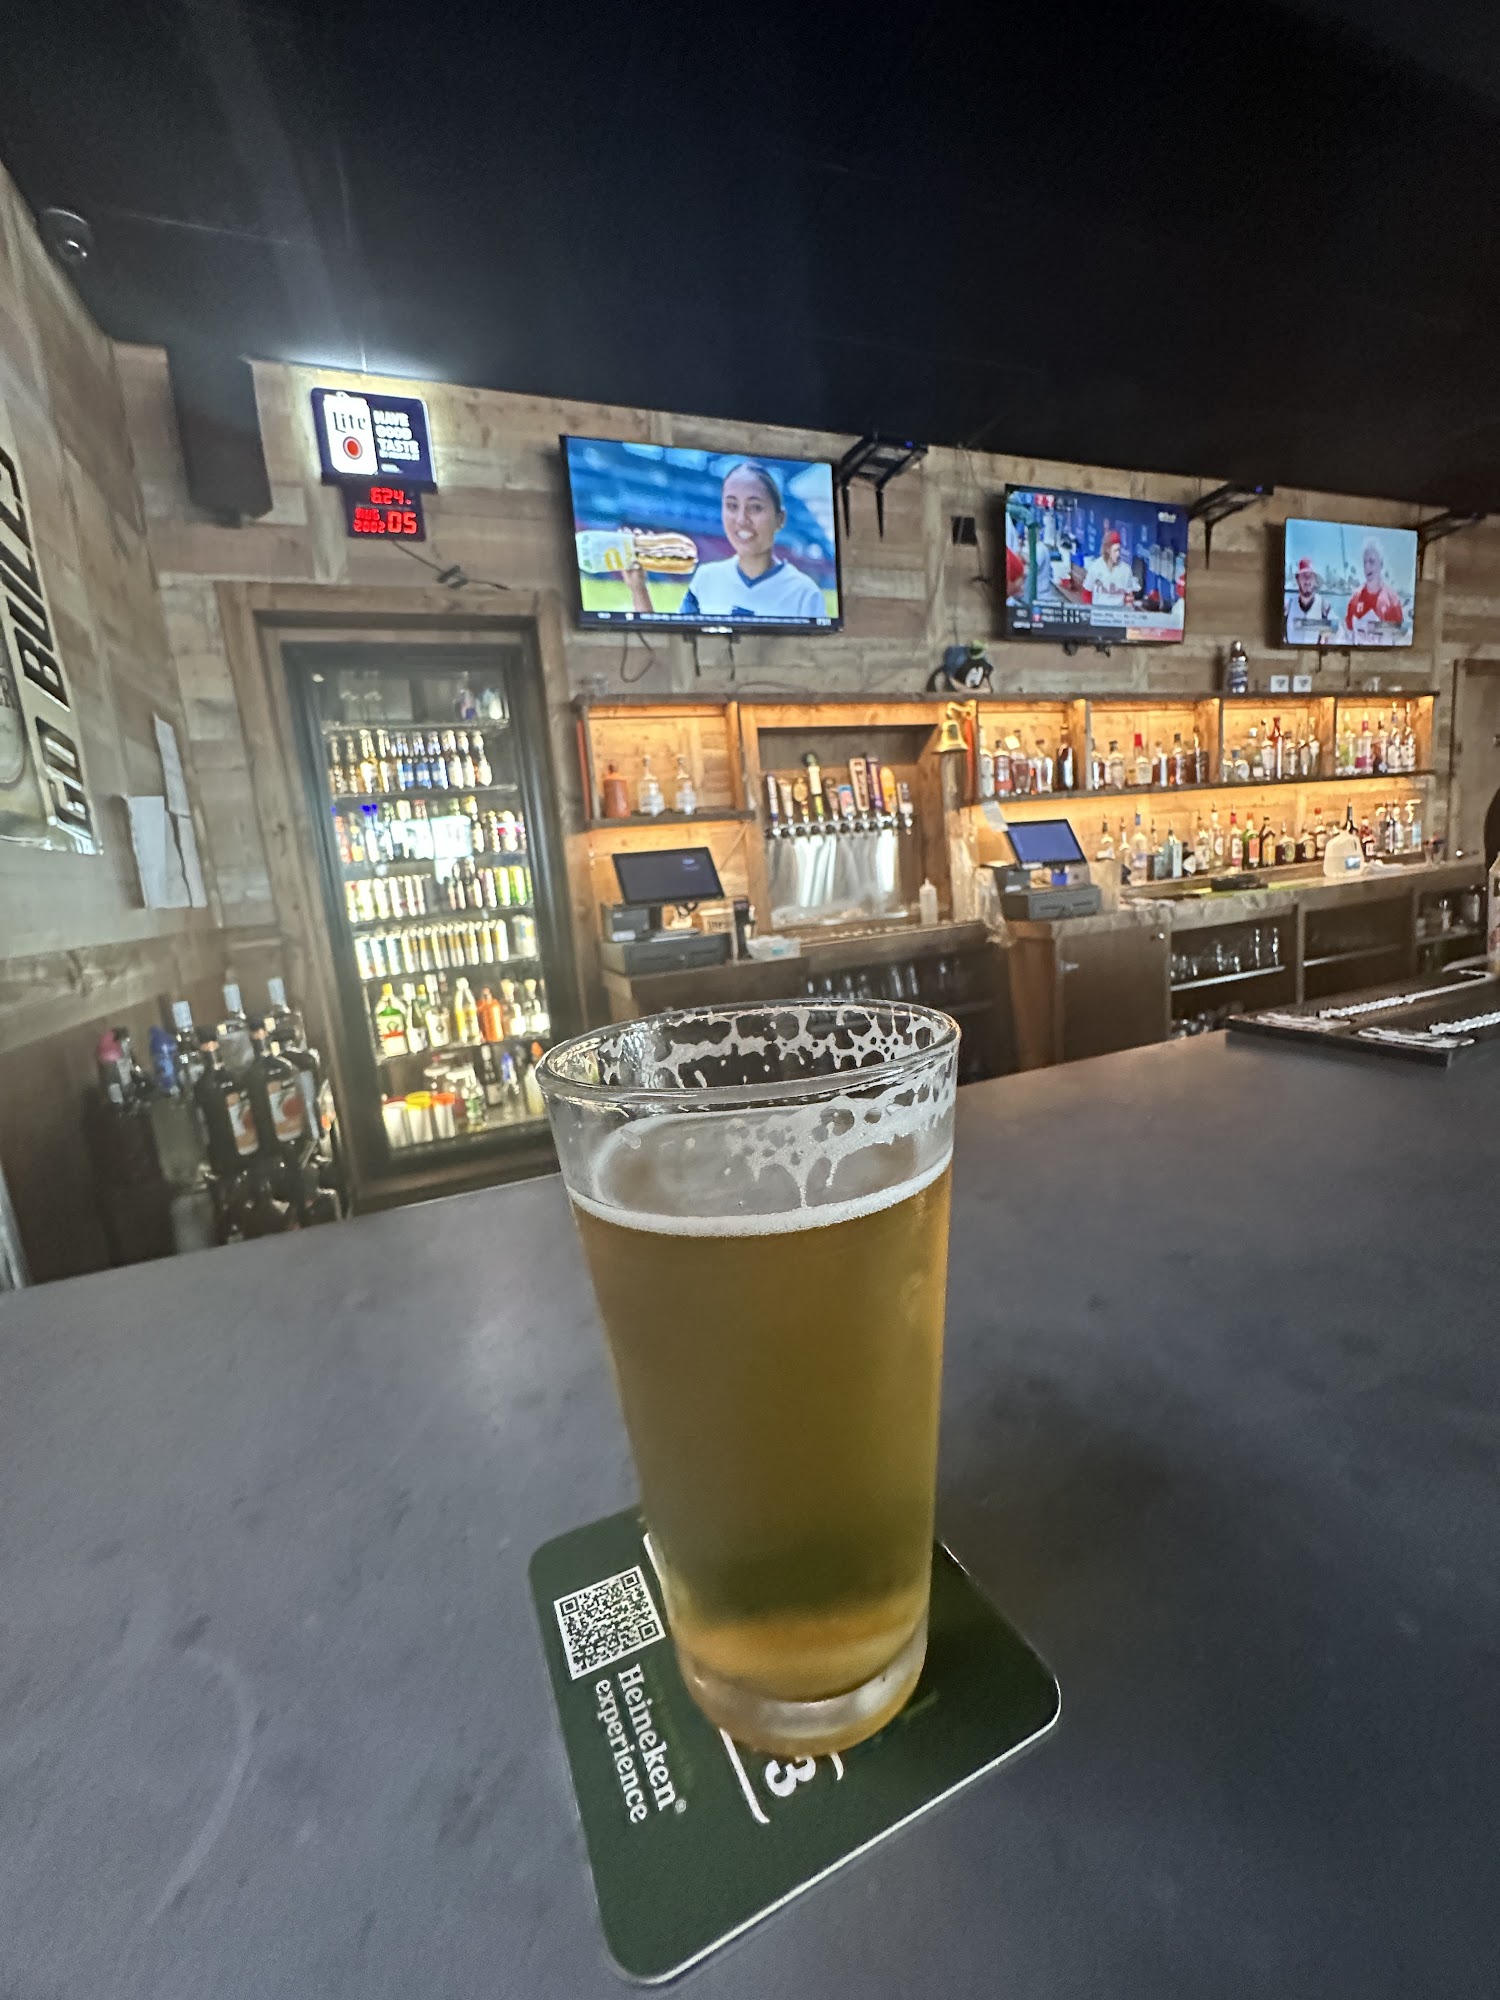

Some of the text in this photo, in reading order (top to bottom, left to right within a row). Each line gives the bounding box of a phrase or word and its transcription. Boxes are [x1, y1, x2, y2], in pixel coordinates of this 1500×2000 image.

[333, 411, 366, 433] Lite
[373, 410, 410, 427] HAVE
[375, 425, 413, 440] GOOD
[377, 438, 420, 454] TASTE
[387, 510, 417, 534] 05
[36, 715, 93, 840] GO
[595, 1679, 648, 1823] experience
